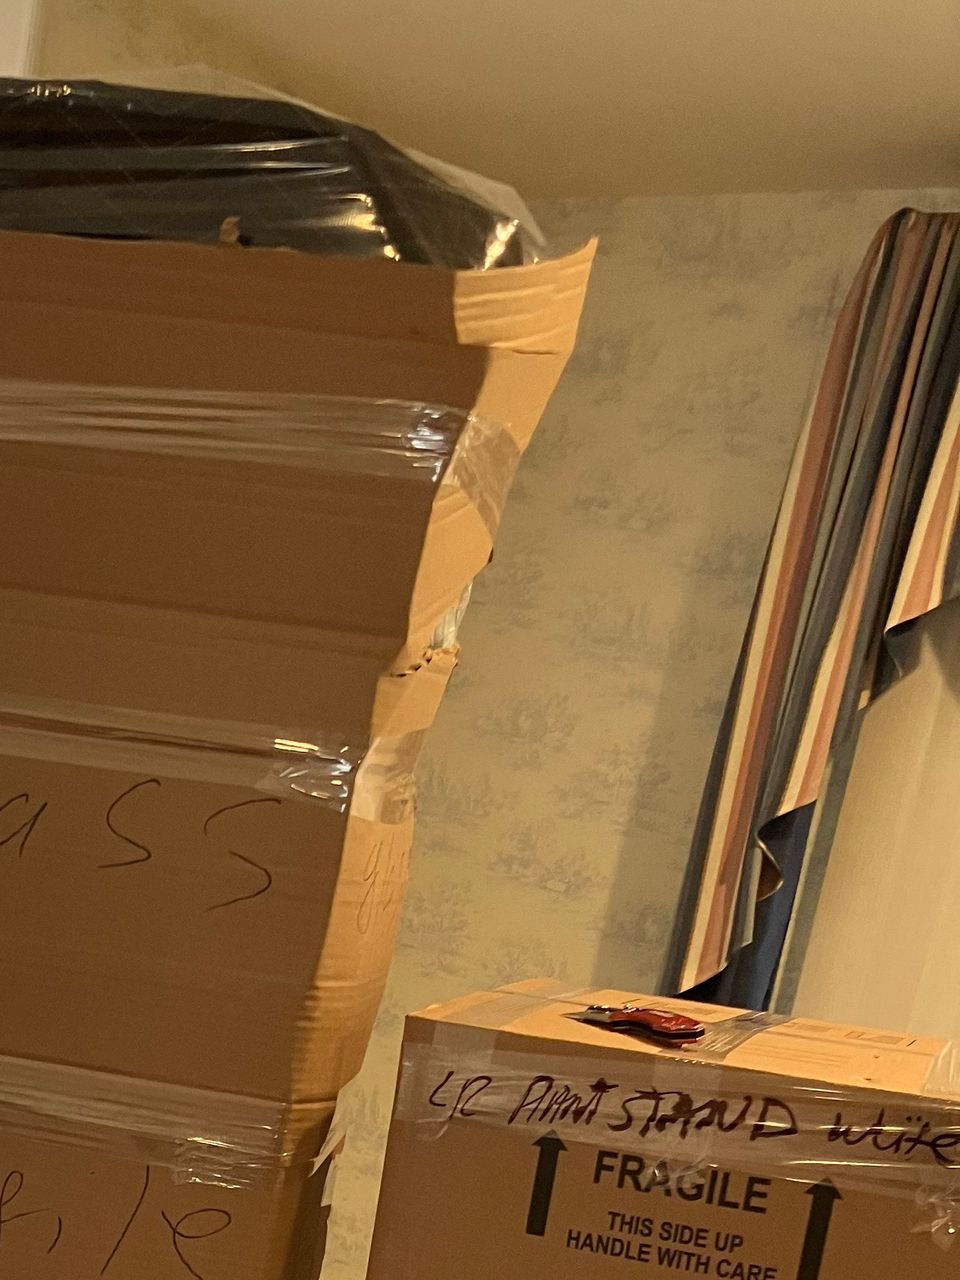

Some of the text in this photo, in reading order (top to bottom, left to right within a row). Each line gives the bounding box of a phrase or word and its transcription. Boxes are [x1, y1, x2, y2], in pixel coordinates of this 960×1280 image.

[593, 1150, 773, 1214] FRAGILE
[566, 1229, 652, 1263] HANDLE
[657, 1246, 711, 1274] WITH
[607, 1210, 745, 1253] THIS SIDE UP
